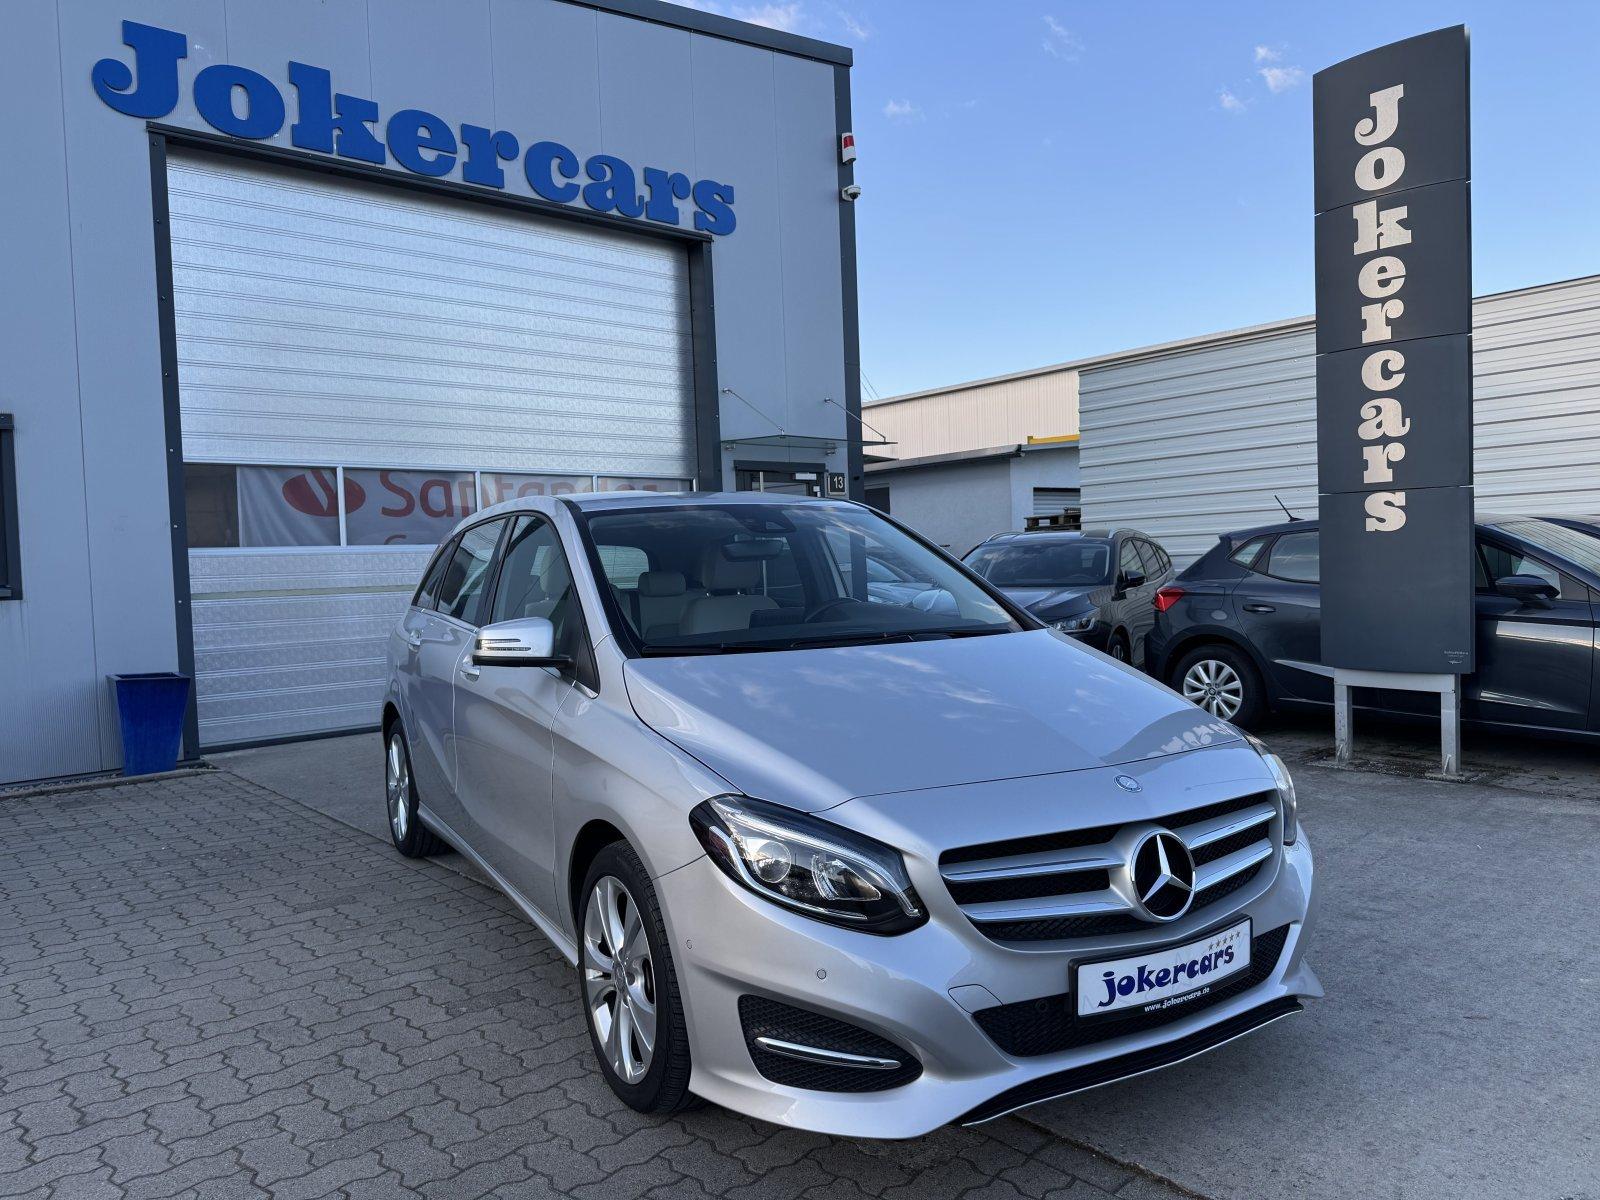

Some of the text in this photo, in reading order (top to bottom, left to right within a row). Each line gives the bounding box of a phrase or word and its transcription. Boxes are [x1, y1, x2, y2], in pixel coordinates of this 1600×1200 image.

[91, 20, 736, 236] Jokercars
[1353, 84, 1412, 532] Jokercars
[379, 471, 657, 517] Santa
[833, 476, 844, 489] 13
[1098, 944, 1235, 1008] jokercars
